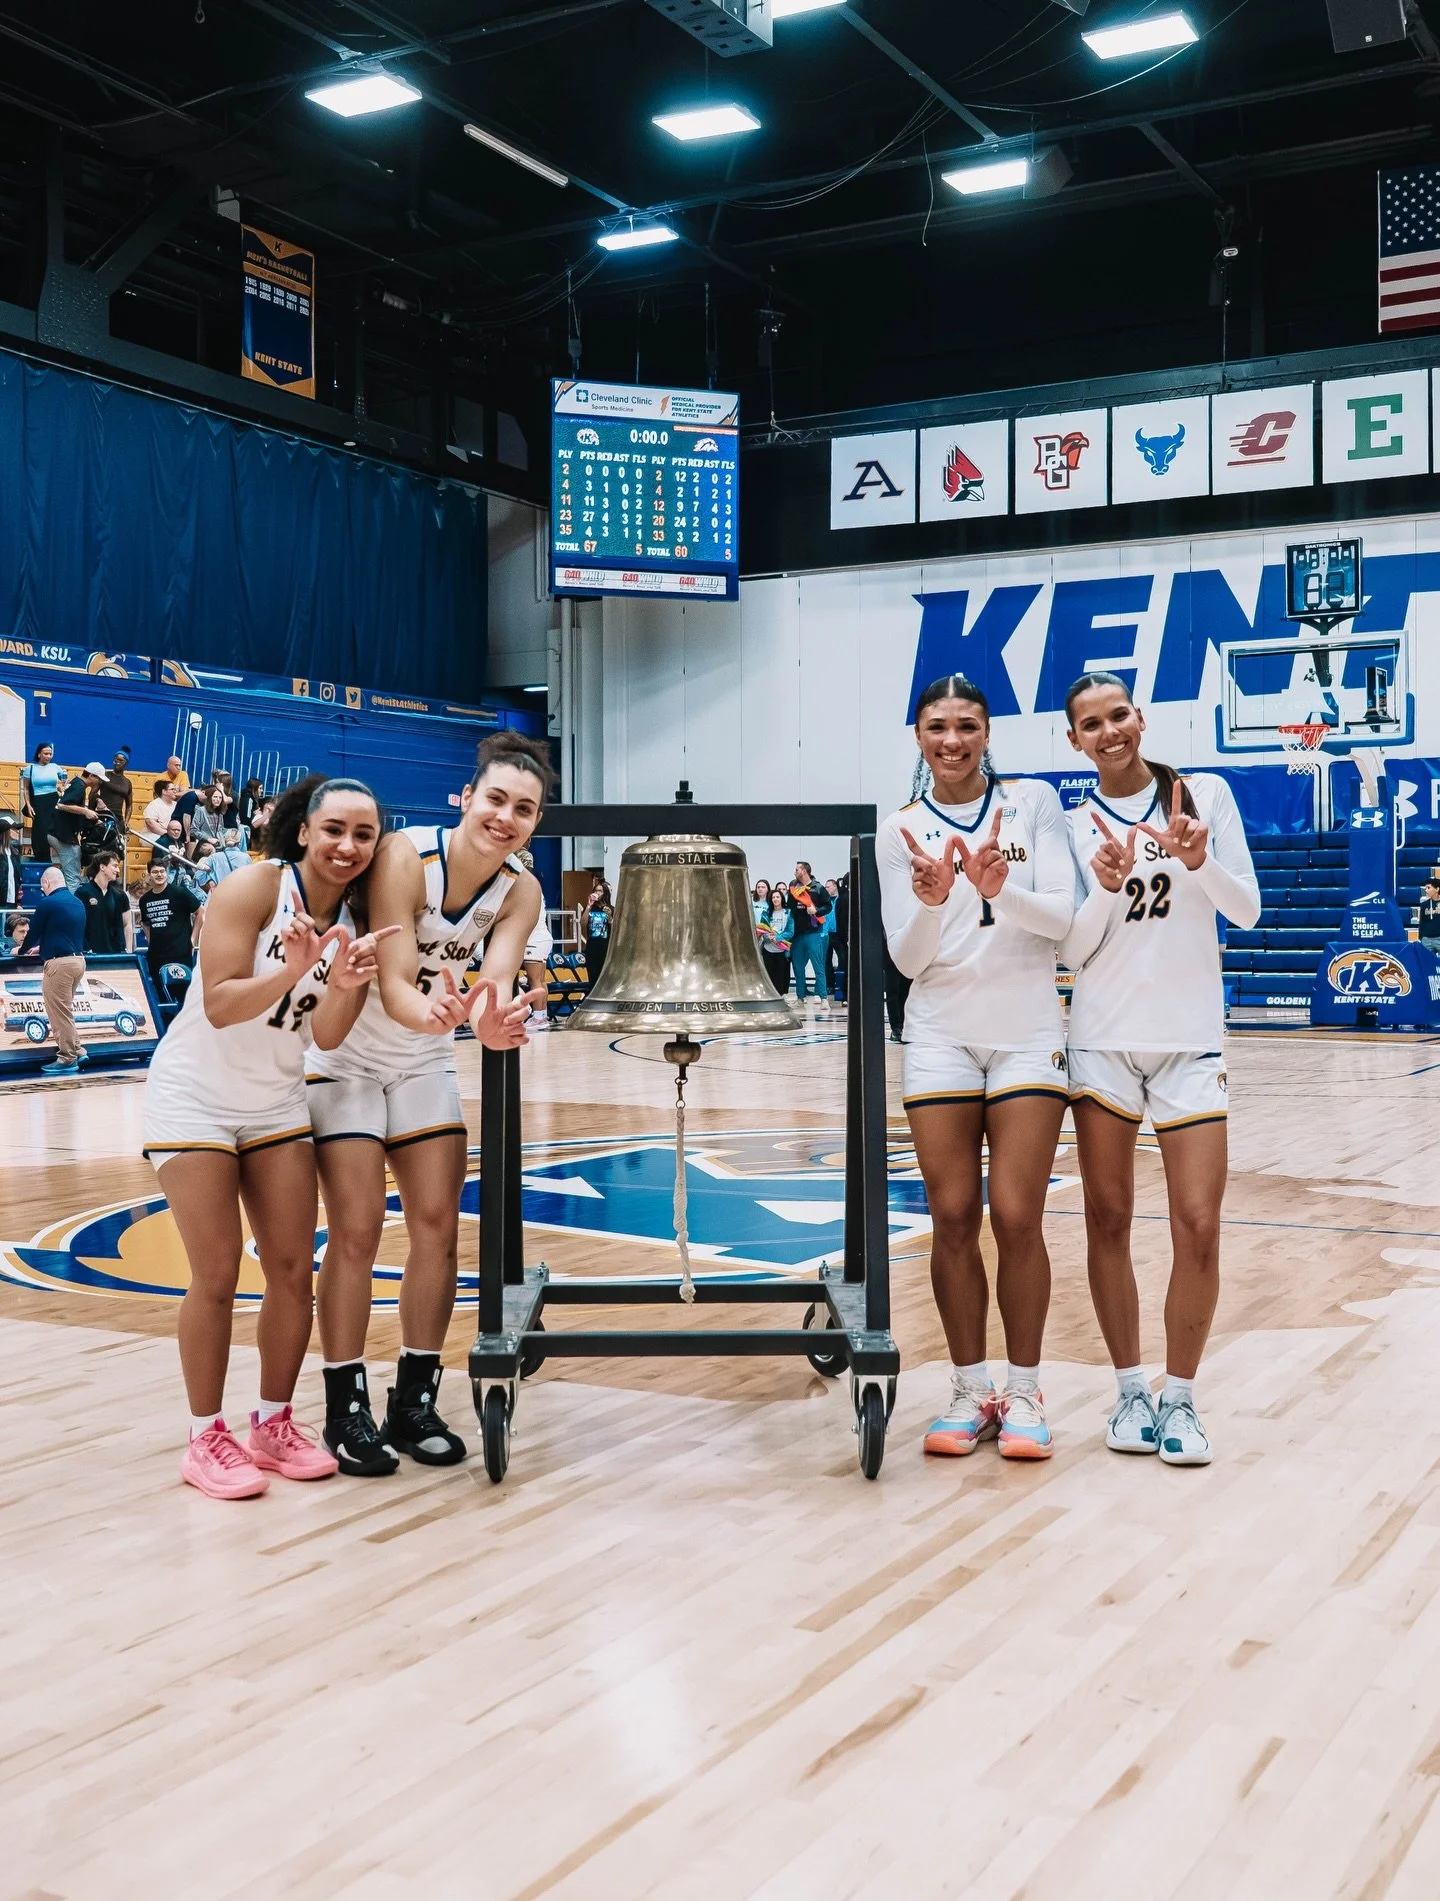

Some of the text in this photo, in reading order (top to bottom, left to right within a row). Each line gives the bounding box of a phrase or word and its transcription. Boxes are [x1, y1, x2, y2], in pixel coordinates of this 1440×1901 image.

[275, 241, 282, 253] K
[246, 251, 308, 281] MEN'S BASKETBALL
[255, 351, 303, 376] KENT STATE
[591, 393, 653, 406] Cleveland Clinic
[630, 429, 669, 445] 0:00.0
[1238, 411, 1297, 456] C
[1347, 393, 1403, 460] E
[558, 449, 735, 469] PLY PTS REB AST FLS PLY PTS REB AST FLS
[1033, 435, 1071, 490] BG
[562, 463, 732, 485] 2 0 0 0 0 2 12 2 0 2
[843, 460, 904, 500] A
[562, 479, 731, 500] 4 3 1 0 2 4 2 1 2 1
[561, 494, 731, 515] 11 11 3 0 2 12 9 7 4 3
[560, 510, 731, 530] 23 27 4 3 2 20 24 2 0 4
[560, 524, 731, 545] 35 4 3 1 1 33 3 2 1 2
[555, 540, 731, 560] TOTAL 67 5 TOTAL 60 5
[905, 552, 1440, 725] KENT
[41, 645, 71, 662] KSU.
[1061, 778, 1098, 787] FLASH'S
[642, 853, 716, 864] KENT STATE
[1125, 873, 1171, 923] 22
[980, 897, 995, 928] 1
[416, 966, 441, 996] 5
[1345, 960, 1389, 994] K
[9, 1002, 46, 1013] STANLE
[617, 1002, 734, 1012] GOLDEN FLASHES
[1267, 997, 1304, 1005] GOLDEN
[1334, 996, 1396, 1004] KENT STATE
